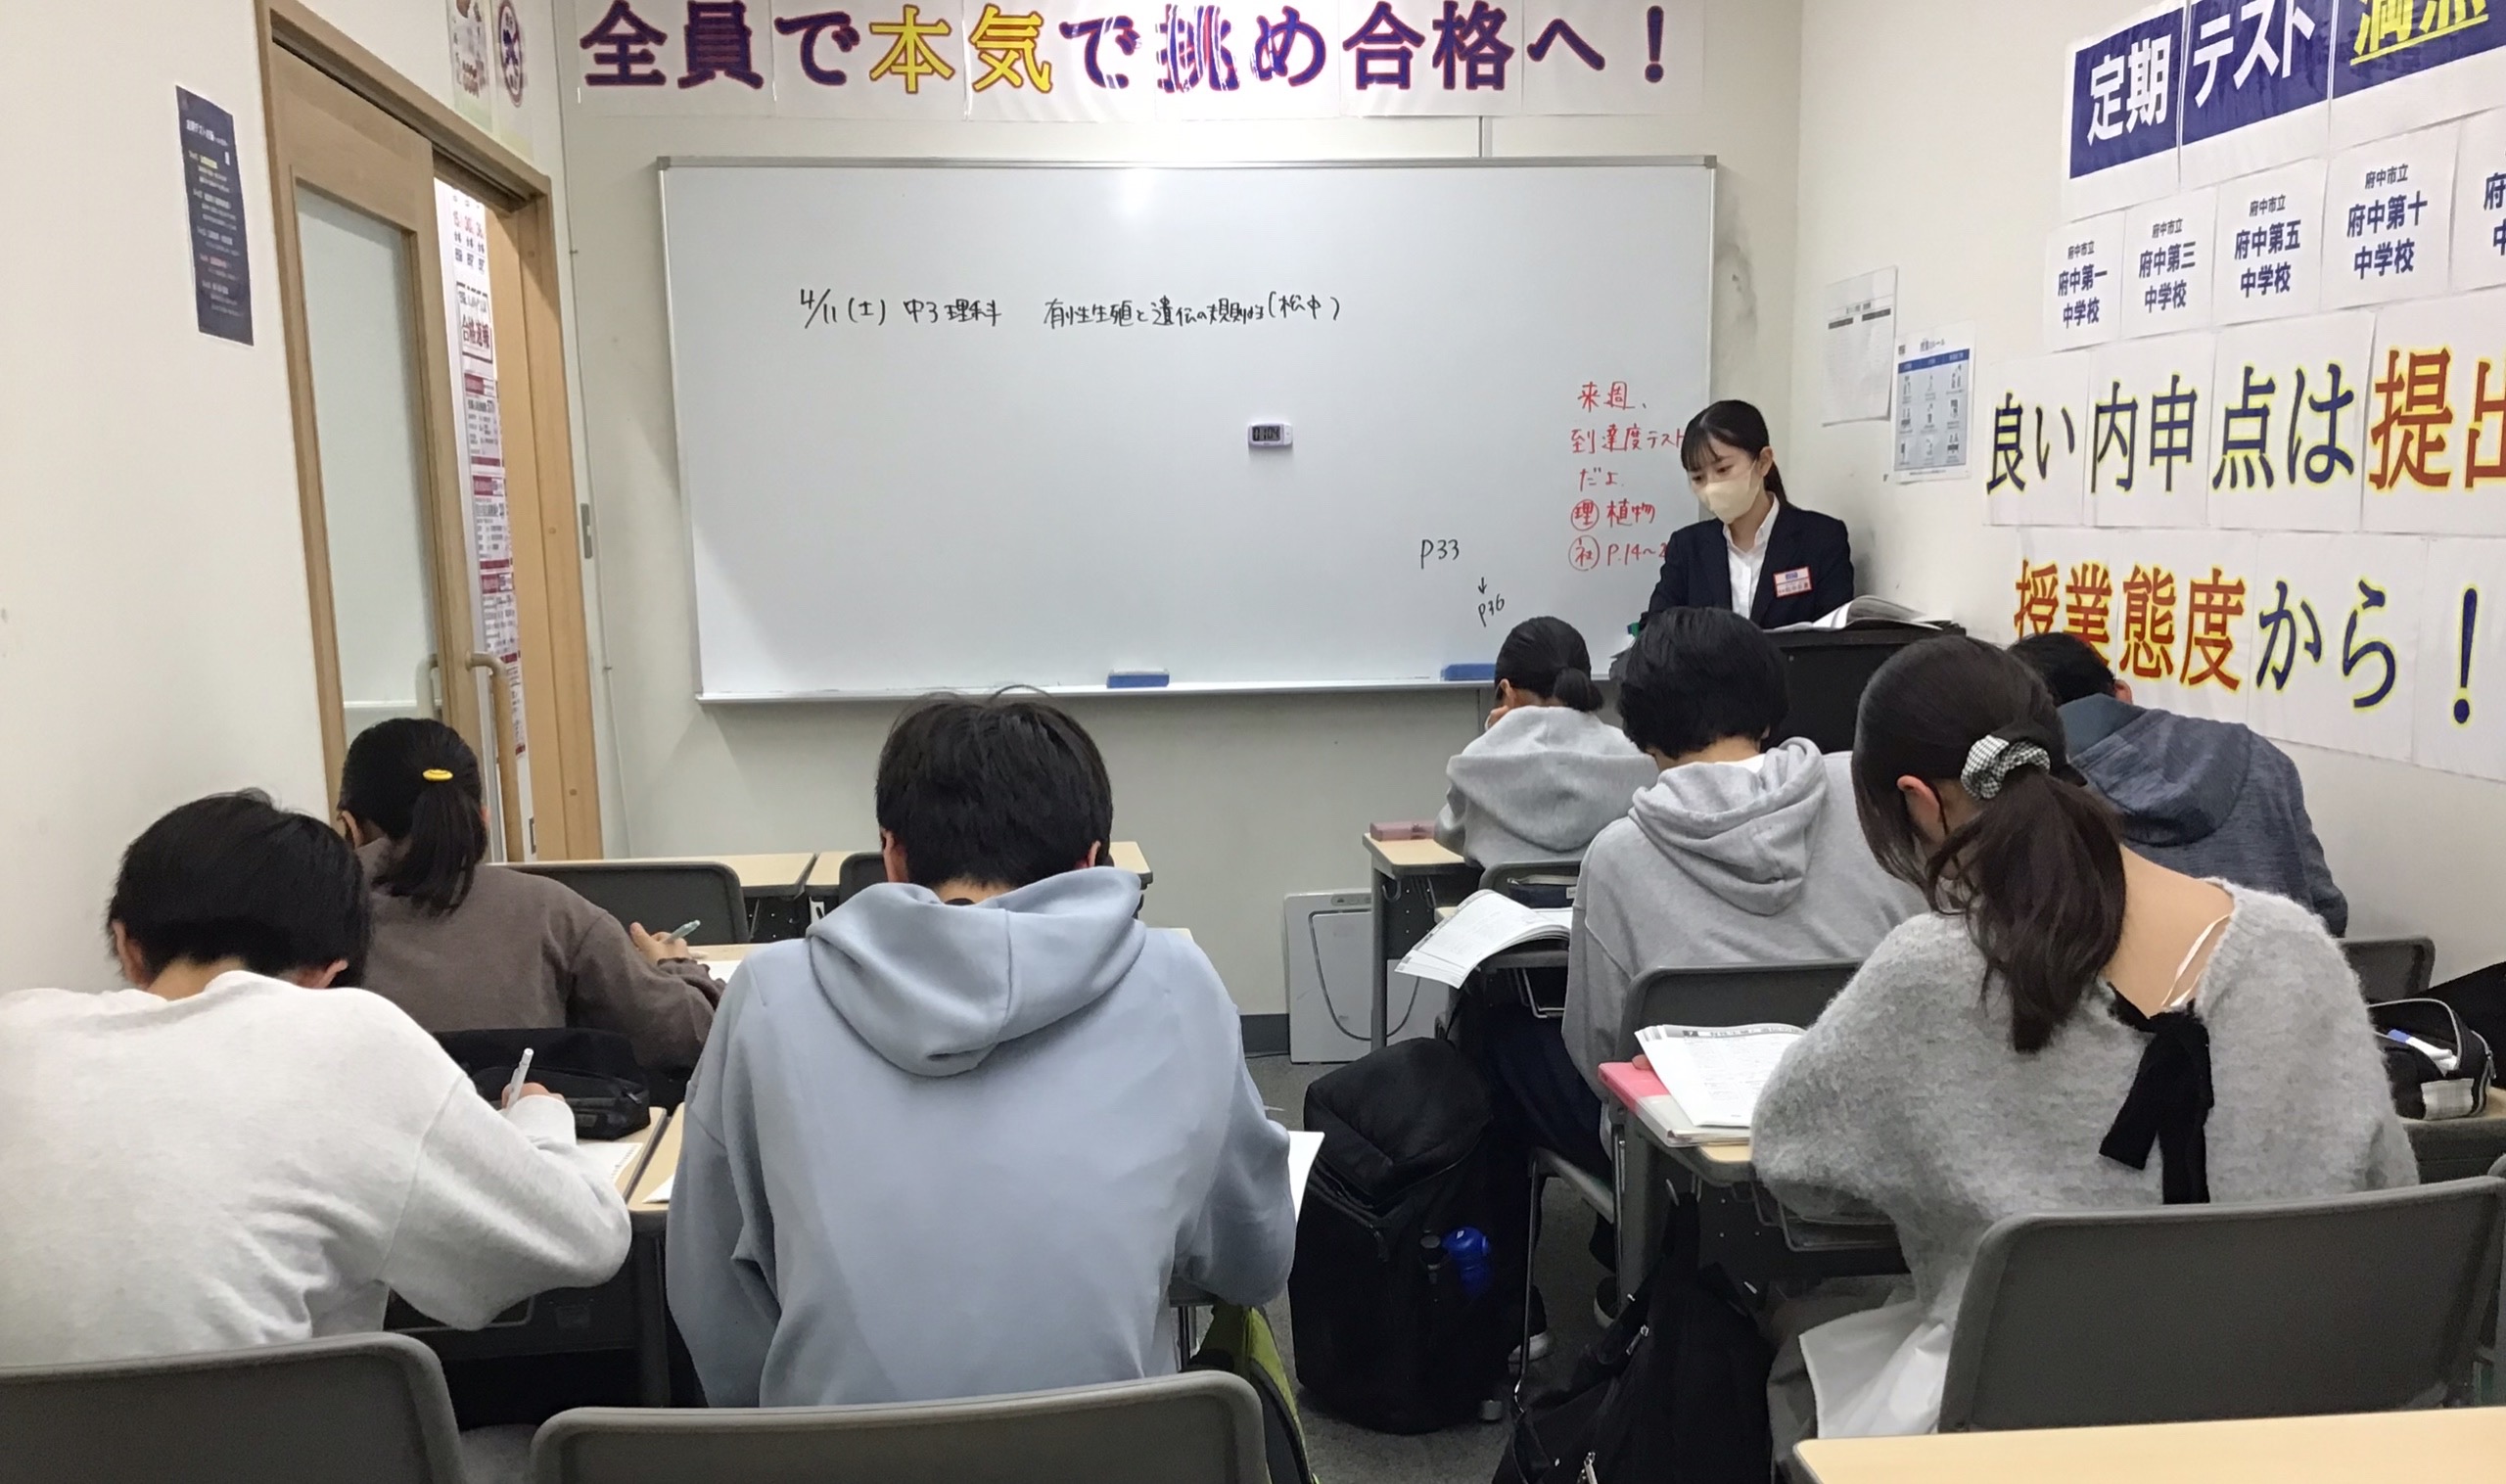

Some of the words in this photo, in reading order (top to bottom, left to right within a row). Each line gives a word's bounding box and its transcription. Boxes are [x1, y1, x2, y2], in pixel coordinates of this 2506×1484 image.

[580, 0, 1664, 94] 全員で本気で挑め合格へ！
[2365, 163, 2409, 189] 府中市立
[2249, 194, 2286, 216] 府中市立
[2346, 190, 2428, 238] 府中第十
[2152, 218, 2183, 238] 府中市立
[2234, 219, 2301, 260] 府中第五
[2067, 241, 2095, 259] 府中市立
[2139, 241, 2196, 279] 府中第三
[2353, 238, 2415, 280] 中学校
[2058, 263, 2108, 297] 府中第一
[2145, 279, 2187, 313] 中学校
[2240, 261, 2292, 299] 中学校
[2063, 297, 2100, 329] 中学校
[1606, 498, 1655, 528] 植物
[2014, 559, 2479, 724] 授業態度から！
